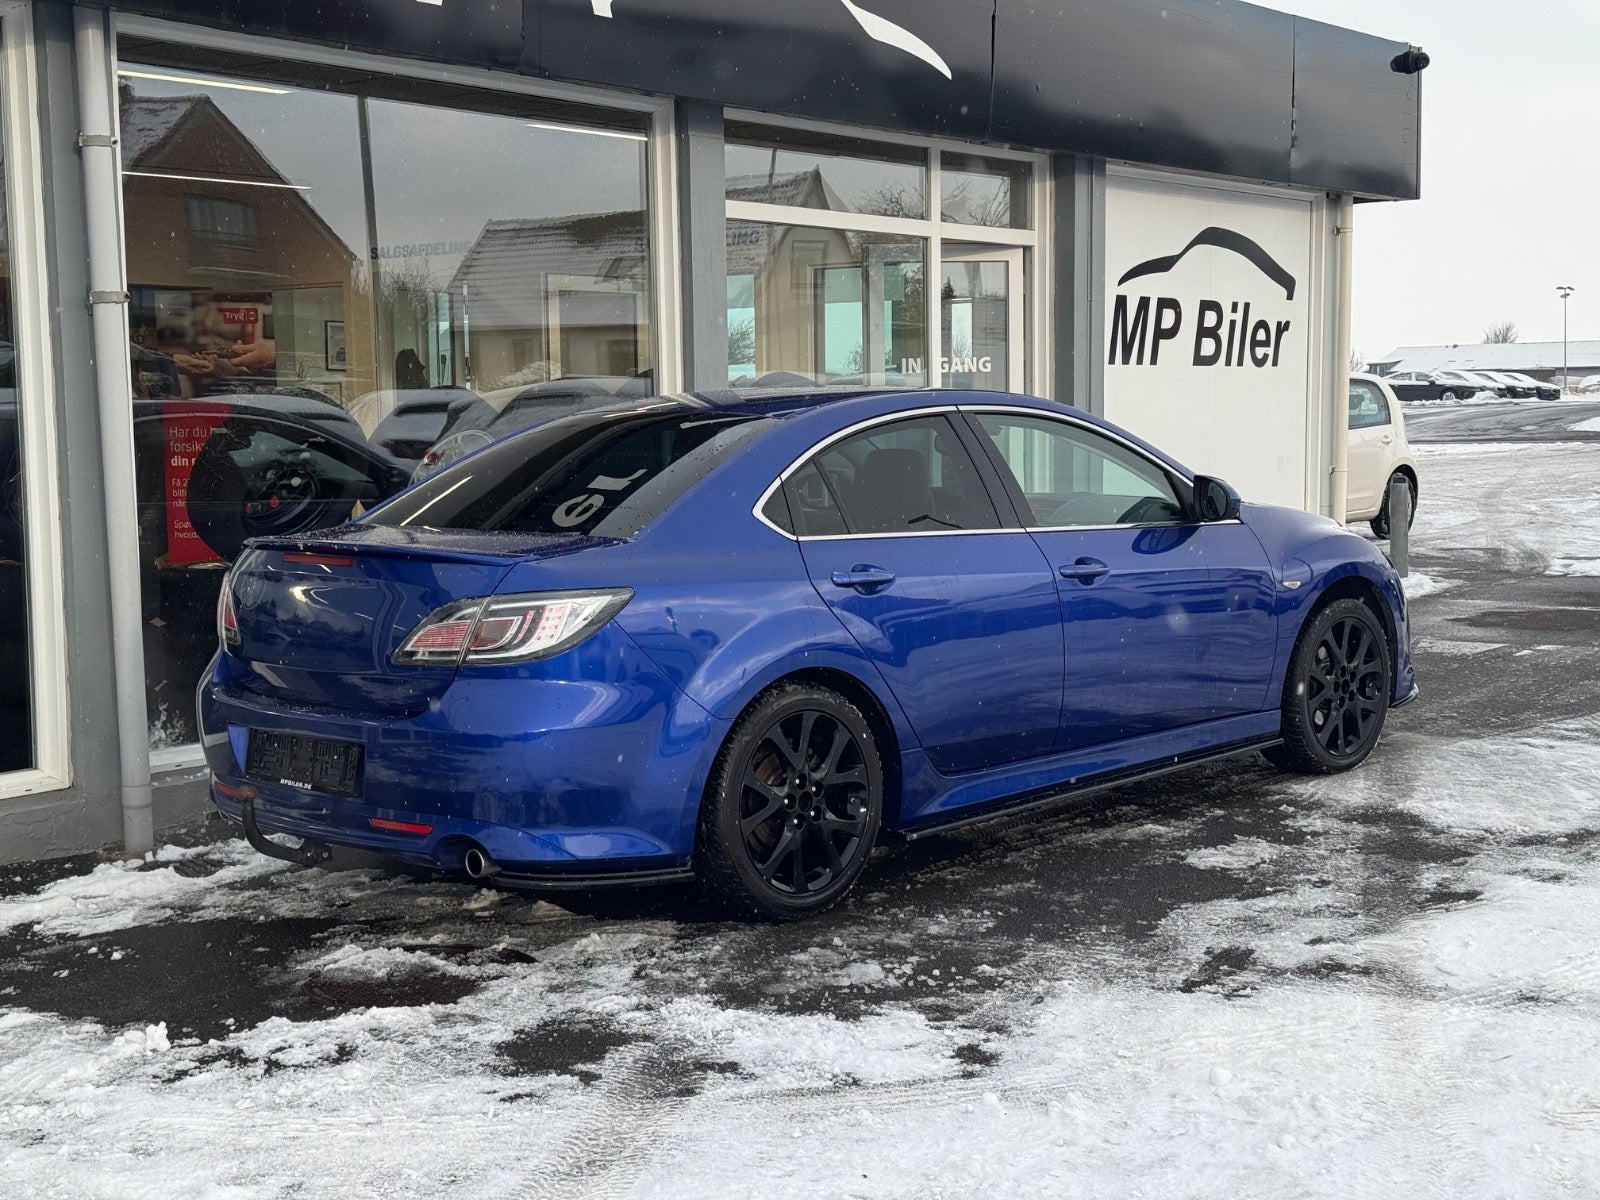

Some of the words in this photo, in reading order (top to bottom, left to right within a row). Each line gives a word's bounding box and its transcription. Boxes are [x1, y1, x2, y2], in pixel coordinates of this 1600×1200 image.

[1108, 294, 1183, 366] MP
[1192, 299, 1291, 368] Biler
[901, 356, 992, 374] INGANG
[169, 426, 190, 438] Har
[192, 426, 207, 438] du
[170, 440, 205, 452] forsik
[171, 455, 189, 467] din
